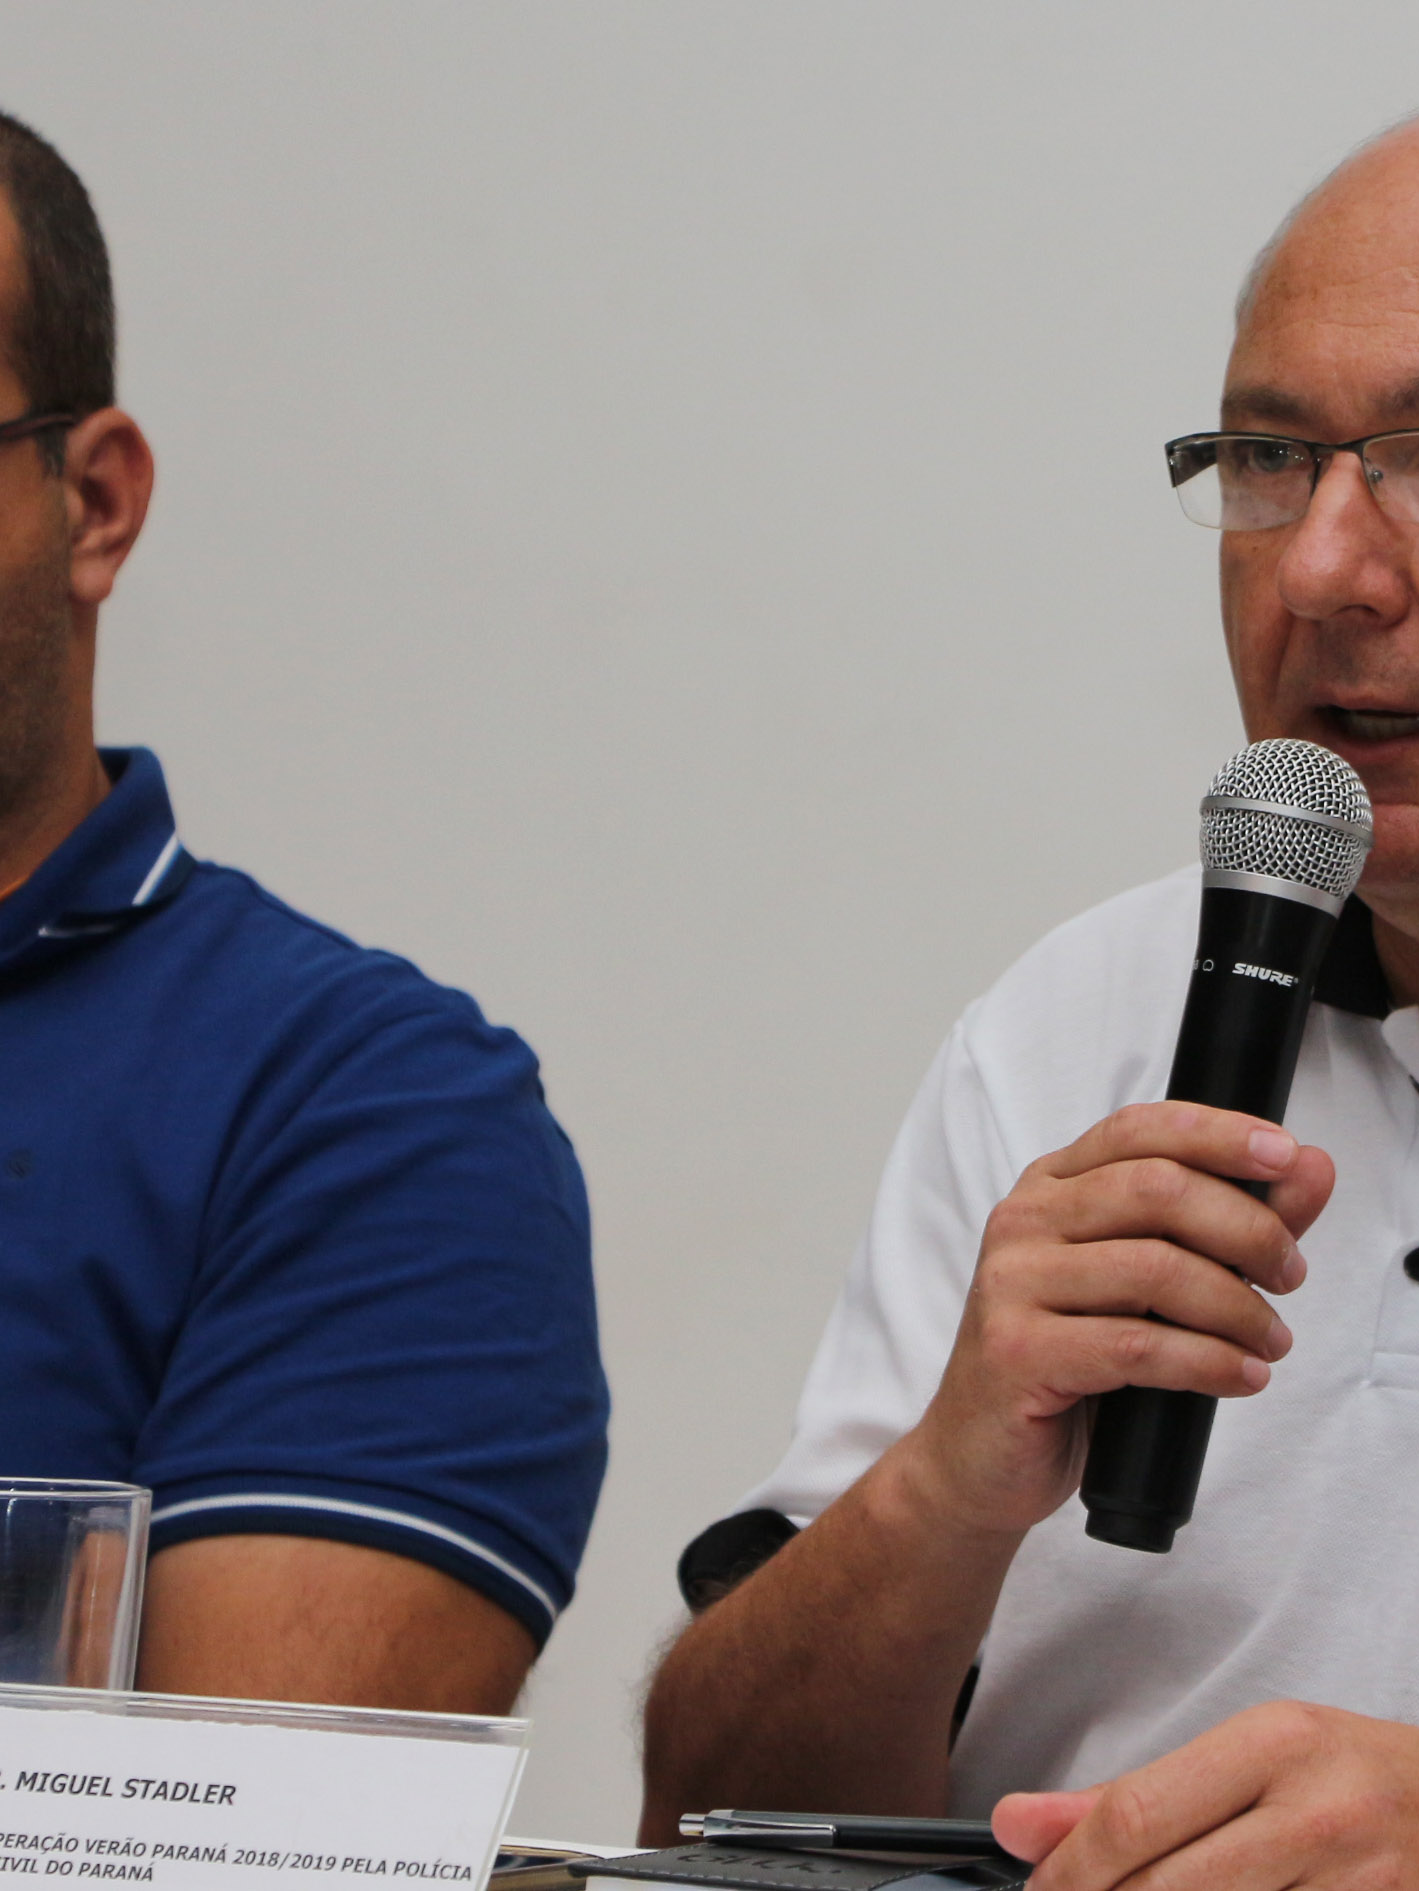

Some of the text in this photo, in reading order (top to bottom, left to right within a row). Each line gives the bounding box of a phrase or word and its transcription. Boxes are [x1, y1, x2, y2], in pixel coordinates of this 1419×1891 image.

[1232, 962, 1294, 987] SHURE
[15, 1770, 113, 1797] MIGUEL
[121, 1778, 237, 1806] STADLER
[0, 1856, 154, 1882] IVIL DO PARANÁ
[85, 1837, 147, 1858] VERÃO
[151, 1842, 229, 1864] PARANÁ
[232, 1849, 337, 1872] 2018/2019
[341, 1857, 387, 1876] PELA
[393, 1858, 472, 1881] POLÍCIA
